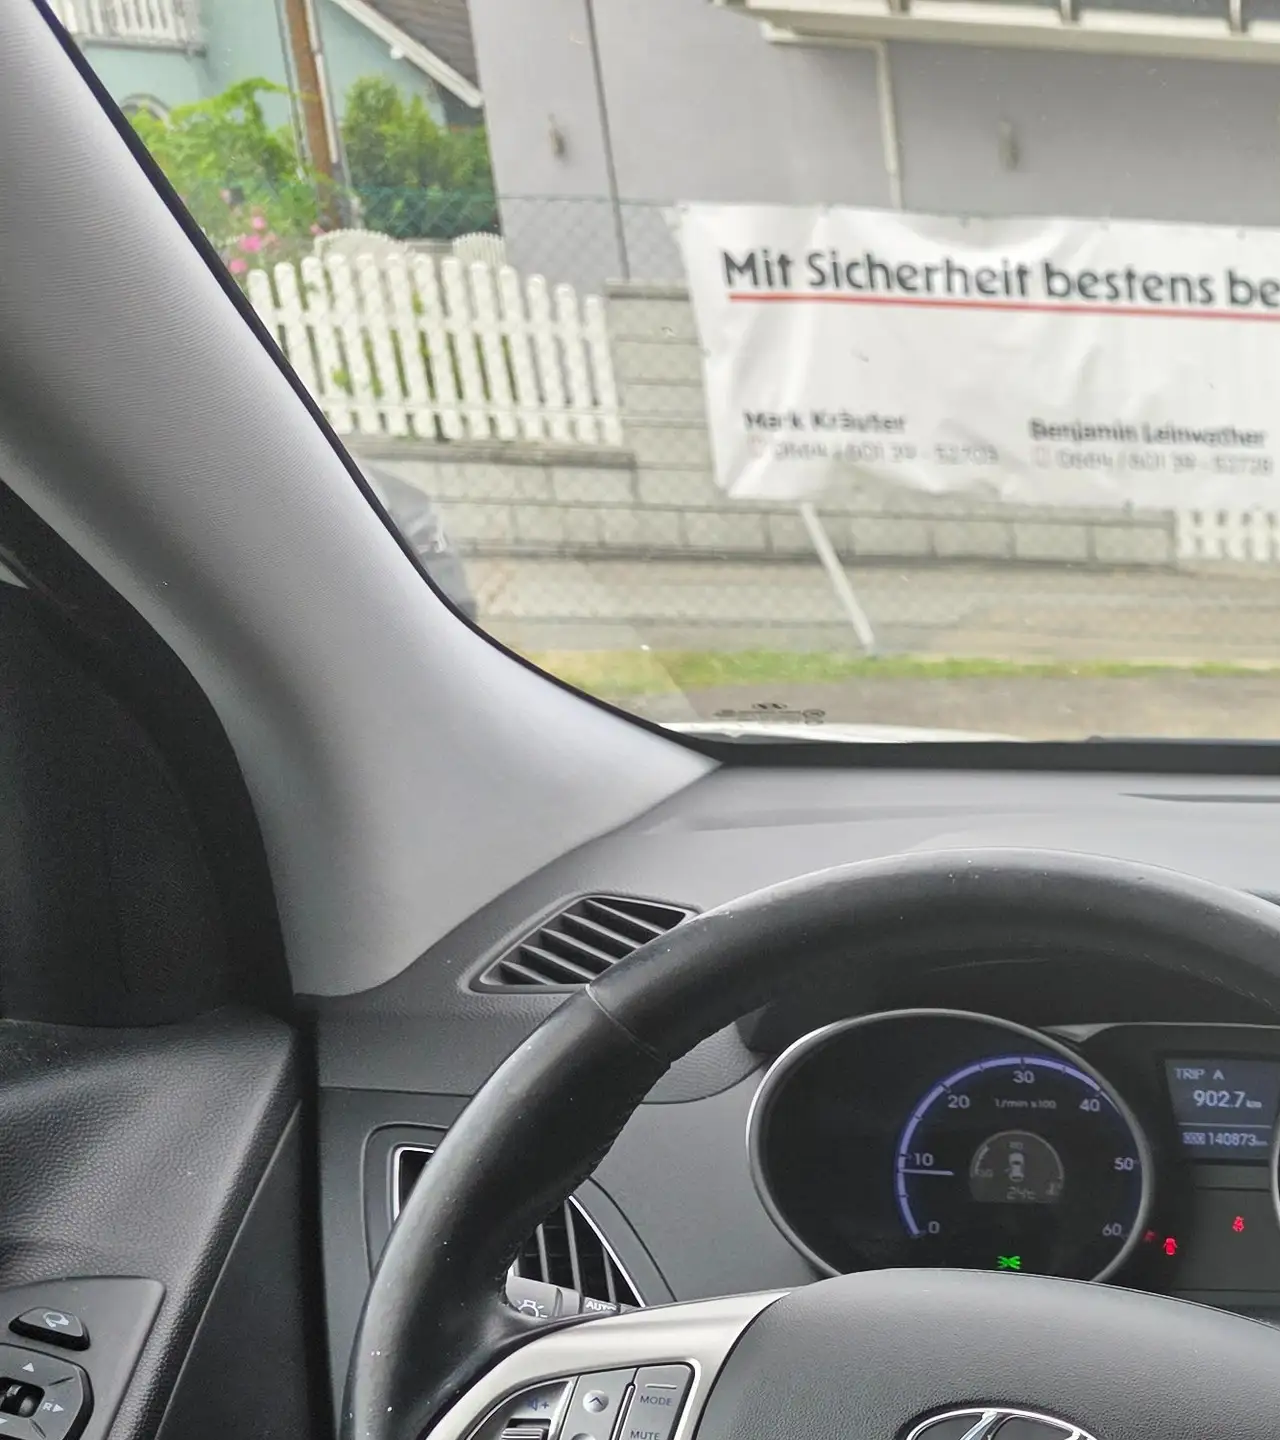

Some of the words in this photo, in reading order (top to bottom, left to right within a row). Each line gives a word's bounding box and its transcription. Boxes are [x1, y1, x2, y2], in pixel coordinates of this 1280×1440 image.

[723, 248, 792, 289] Mit
[804, 250, 1033, 300] Sicherheit
[1043, 261, 1214, 308] bestens
[1012, 1070, 1036, 1085] 30
[1174, 1067, 1205, 1080] TRIP
[1213, 1069, 1225, 1080] A
[947, 1094, 970, 1109] 20
[1079, 1098, 1101, 1113] 40
[1193, 1089, 1246, 1108] 902.7
[914, 1152, 934, 1167] 10
[1114, 1157, 1134, 1171] 50
[928, 1221, 941, 1235] 0
[1102, 1222, 1123, 1237] 60
[640, 1395, 673, 1406] MODE
